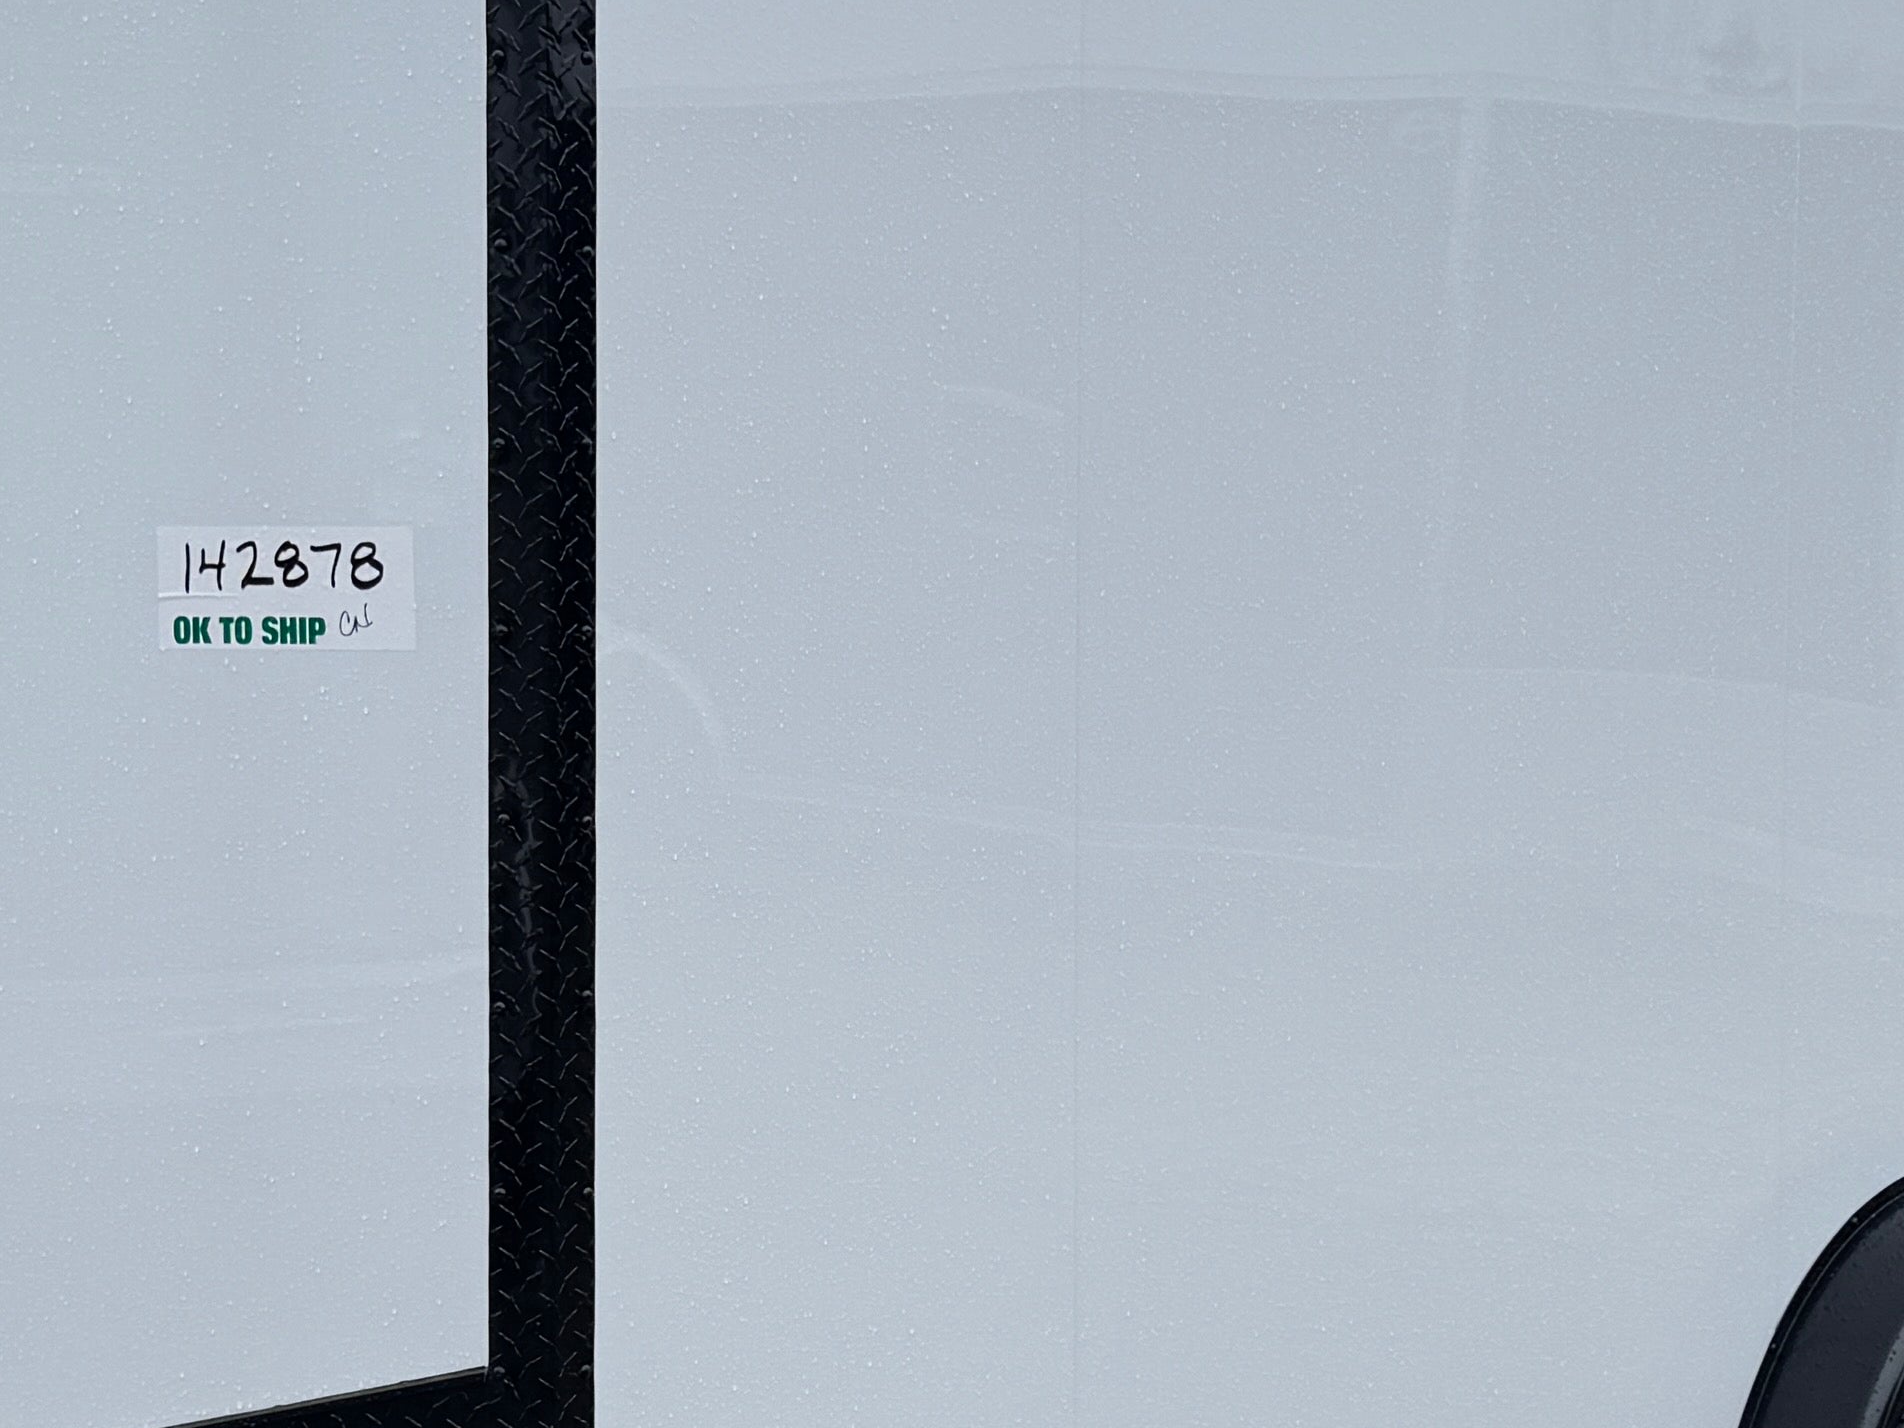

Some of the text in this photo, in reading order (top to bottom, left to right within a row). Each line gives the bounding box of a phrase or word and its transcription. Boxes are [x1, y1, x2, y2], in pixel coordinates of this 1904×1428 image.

[184, 539, 384, 594] 142878
[173, 616, 326, 645] OK TO SHIP
